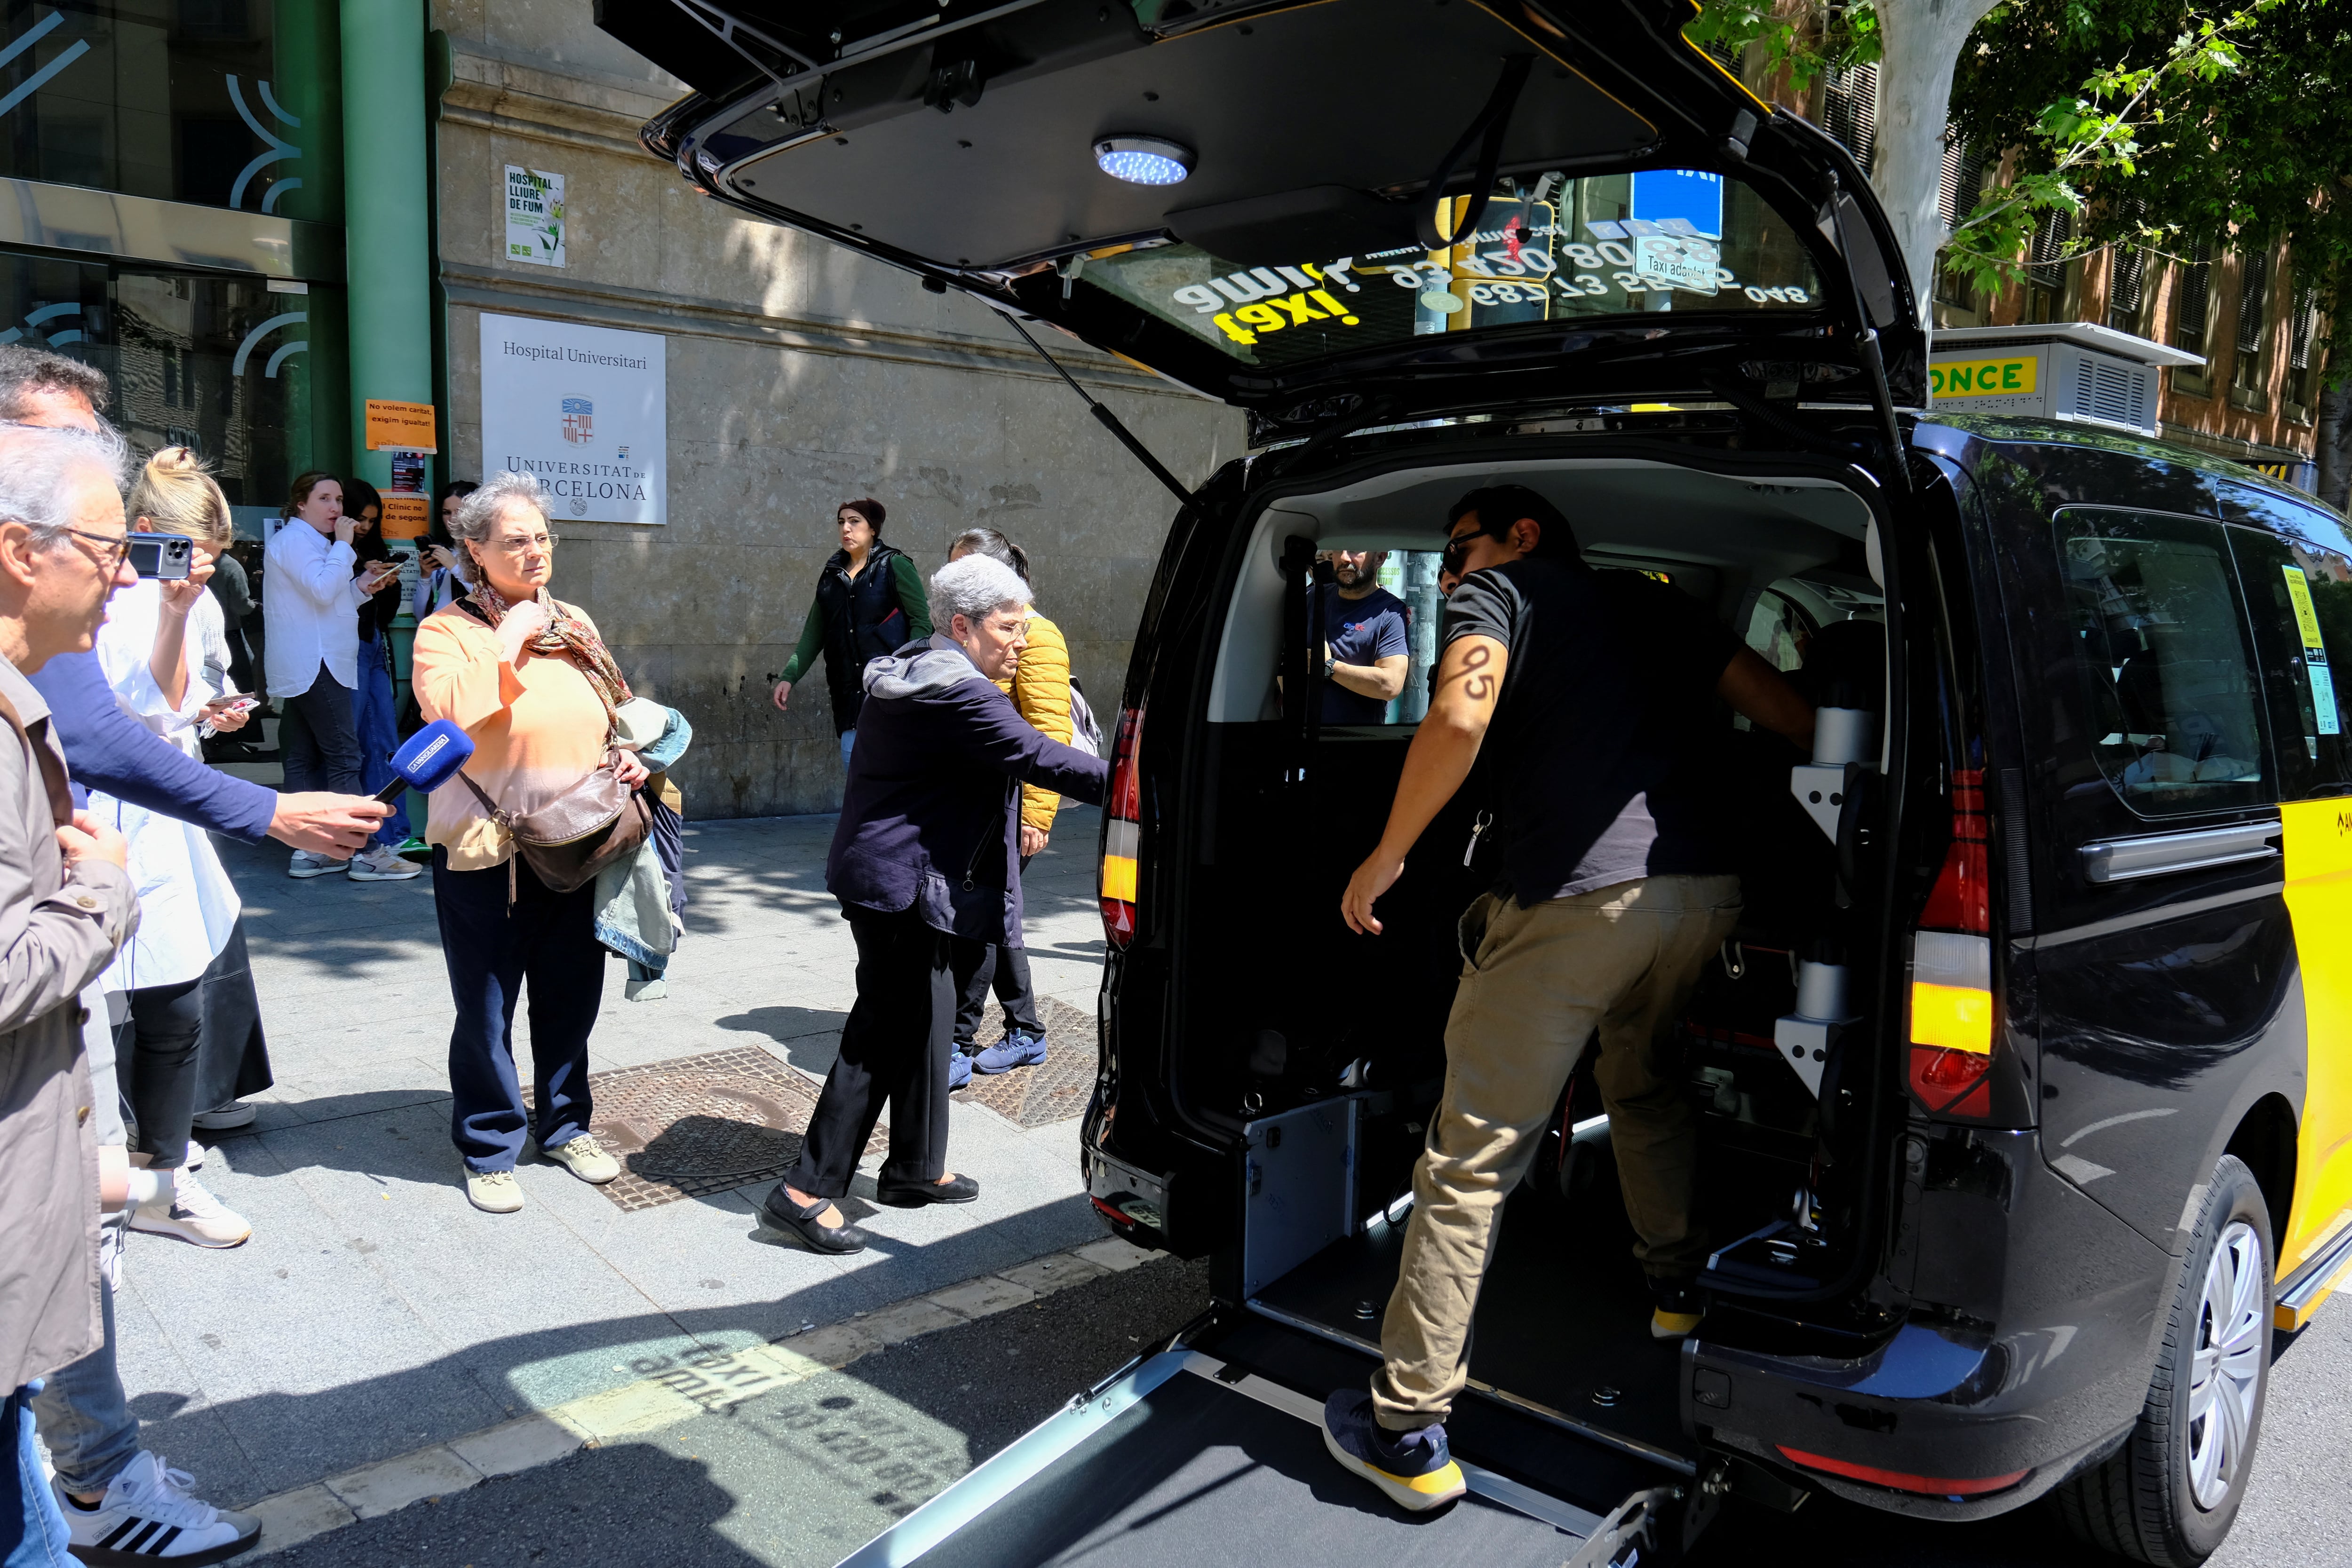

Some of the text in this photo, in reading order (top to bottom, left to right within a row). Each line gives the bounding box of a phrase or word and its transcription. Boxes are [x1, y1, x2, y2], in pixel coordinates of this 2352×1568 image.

[509, 172, 553, 190] HOSPITAL
[510, 185, 540, 200] LLIURE
[510, 198, 543, 214] DE FUM
[1648, 255, 1667, 273] Taxi
[503, 341, 647, 370] Hospital Universitari
[1930, 364, 2023, 393] ONCE
[402, 418, 430, 427] igualtat!
[507, 456, 631, 477] UNIVERSITAT
[539, 479, 646, 500] RCELONA
[415, 736, 446, 764] VANGUARDIA
